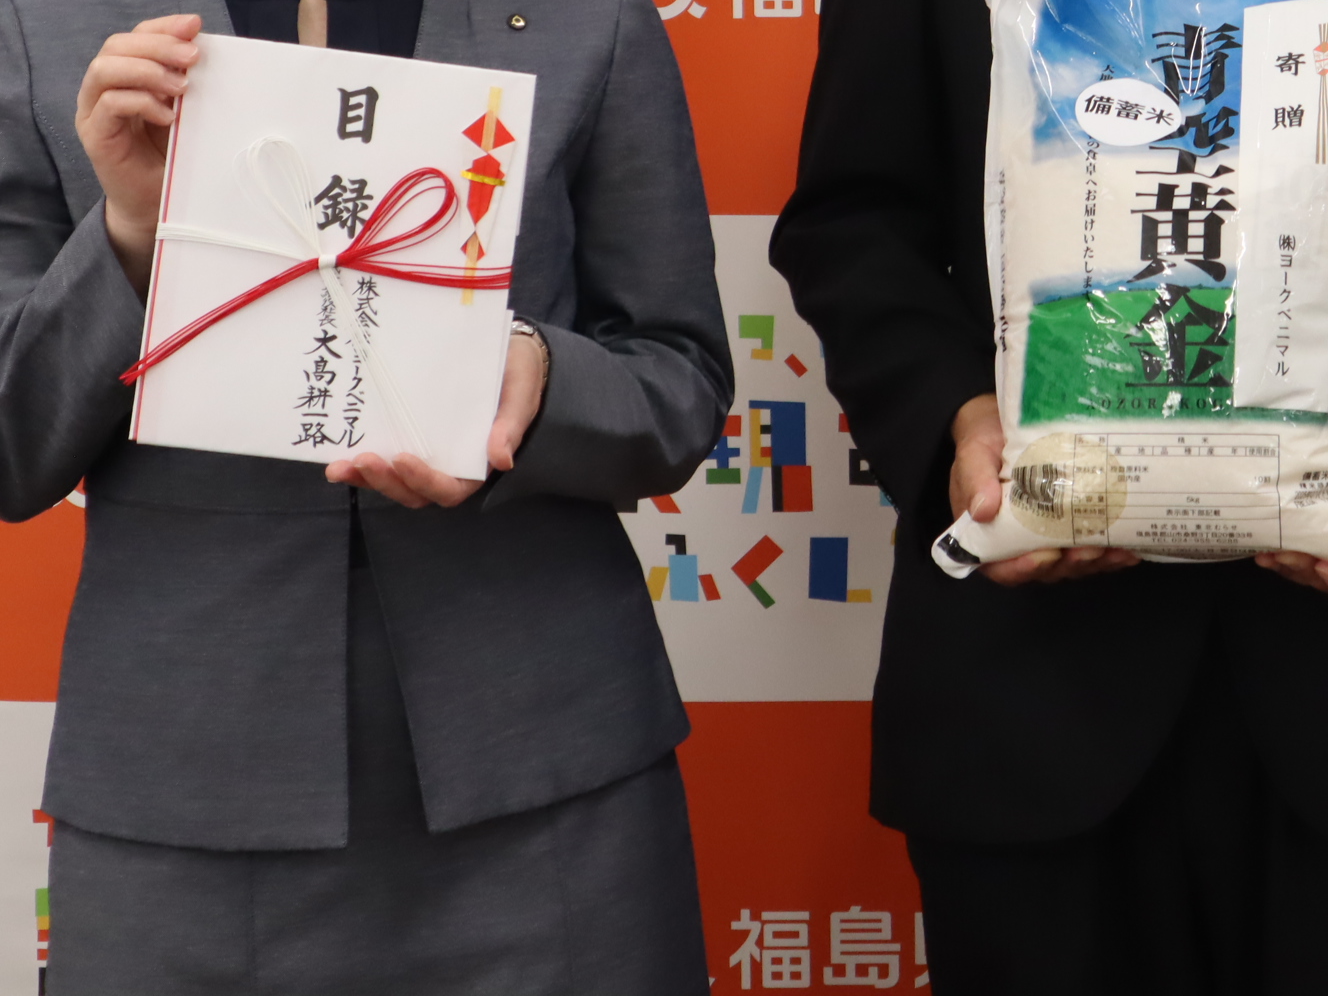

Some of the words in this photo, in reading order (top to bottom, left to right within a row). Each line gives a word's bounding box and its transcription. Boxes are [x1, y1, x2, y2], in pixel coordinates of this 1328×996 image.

[1084, 94, 1175, 127] 備蓄米
[1272, 51, 1306, 130] 寄贈
[308, 86, 379, 239] 目録
[1083, 134, 1100, 301] の食卓へお届けいたしま
